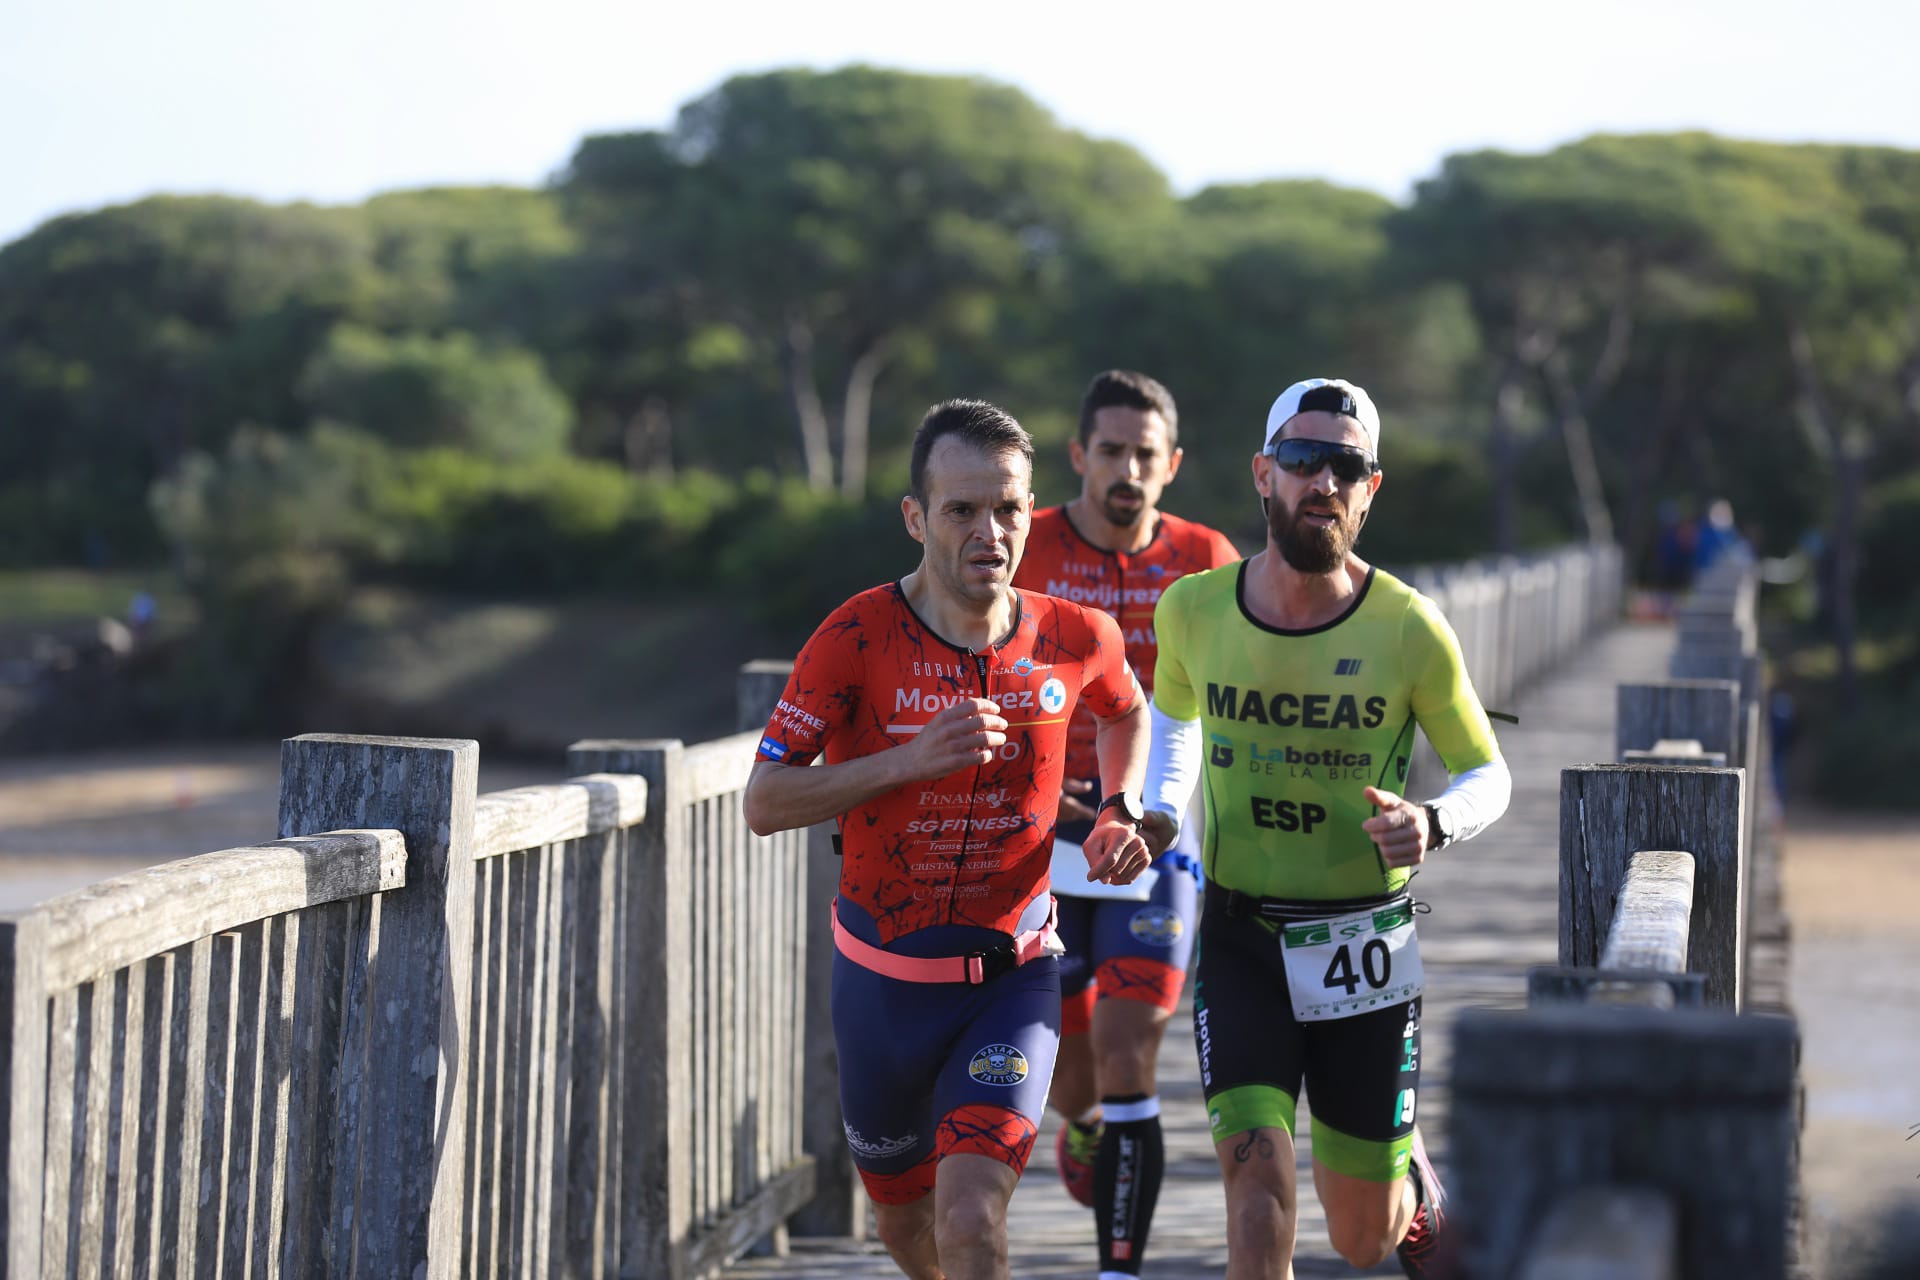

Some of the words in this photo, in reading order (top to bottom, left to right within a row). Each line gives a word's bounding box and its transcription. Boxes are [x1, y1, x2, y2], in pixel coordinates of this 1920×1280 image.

[913, 661, 964, 679] GOBIK
[1207, 682, 1387, 730] MACEAS
[1249, 743, 1372, 766] Labotica
[1249, 760, 1273, 776] DE
[1290, 766, 1313, 778] LA
[1329, 767, 1372, 781] BICI
[1250, 796, 1327, 834] ESP
[1323, 938, 1392, 996] 40
[981, 1046, 1015, 1057] PATAN
[980, 1073, 1020, 1083] TATTOO
